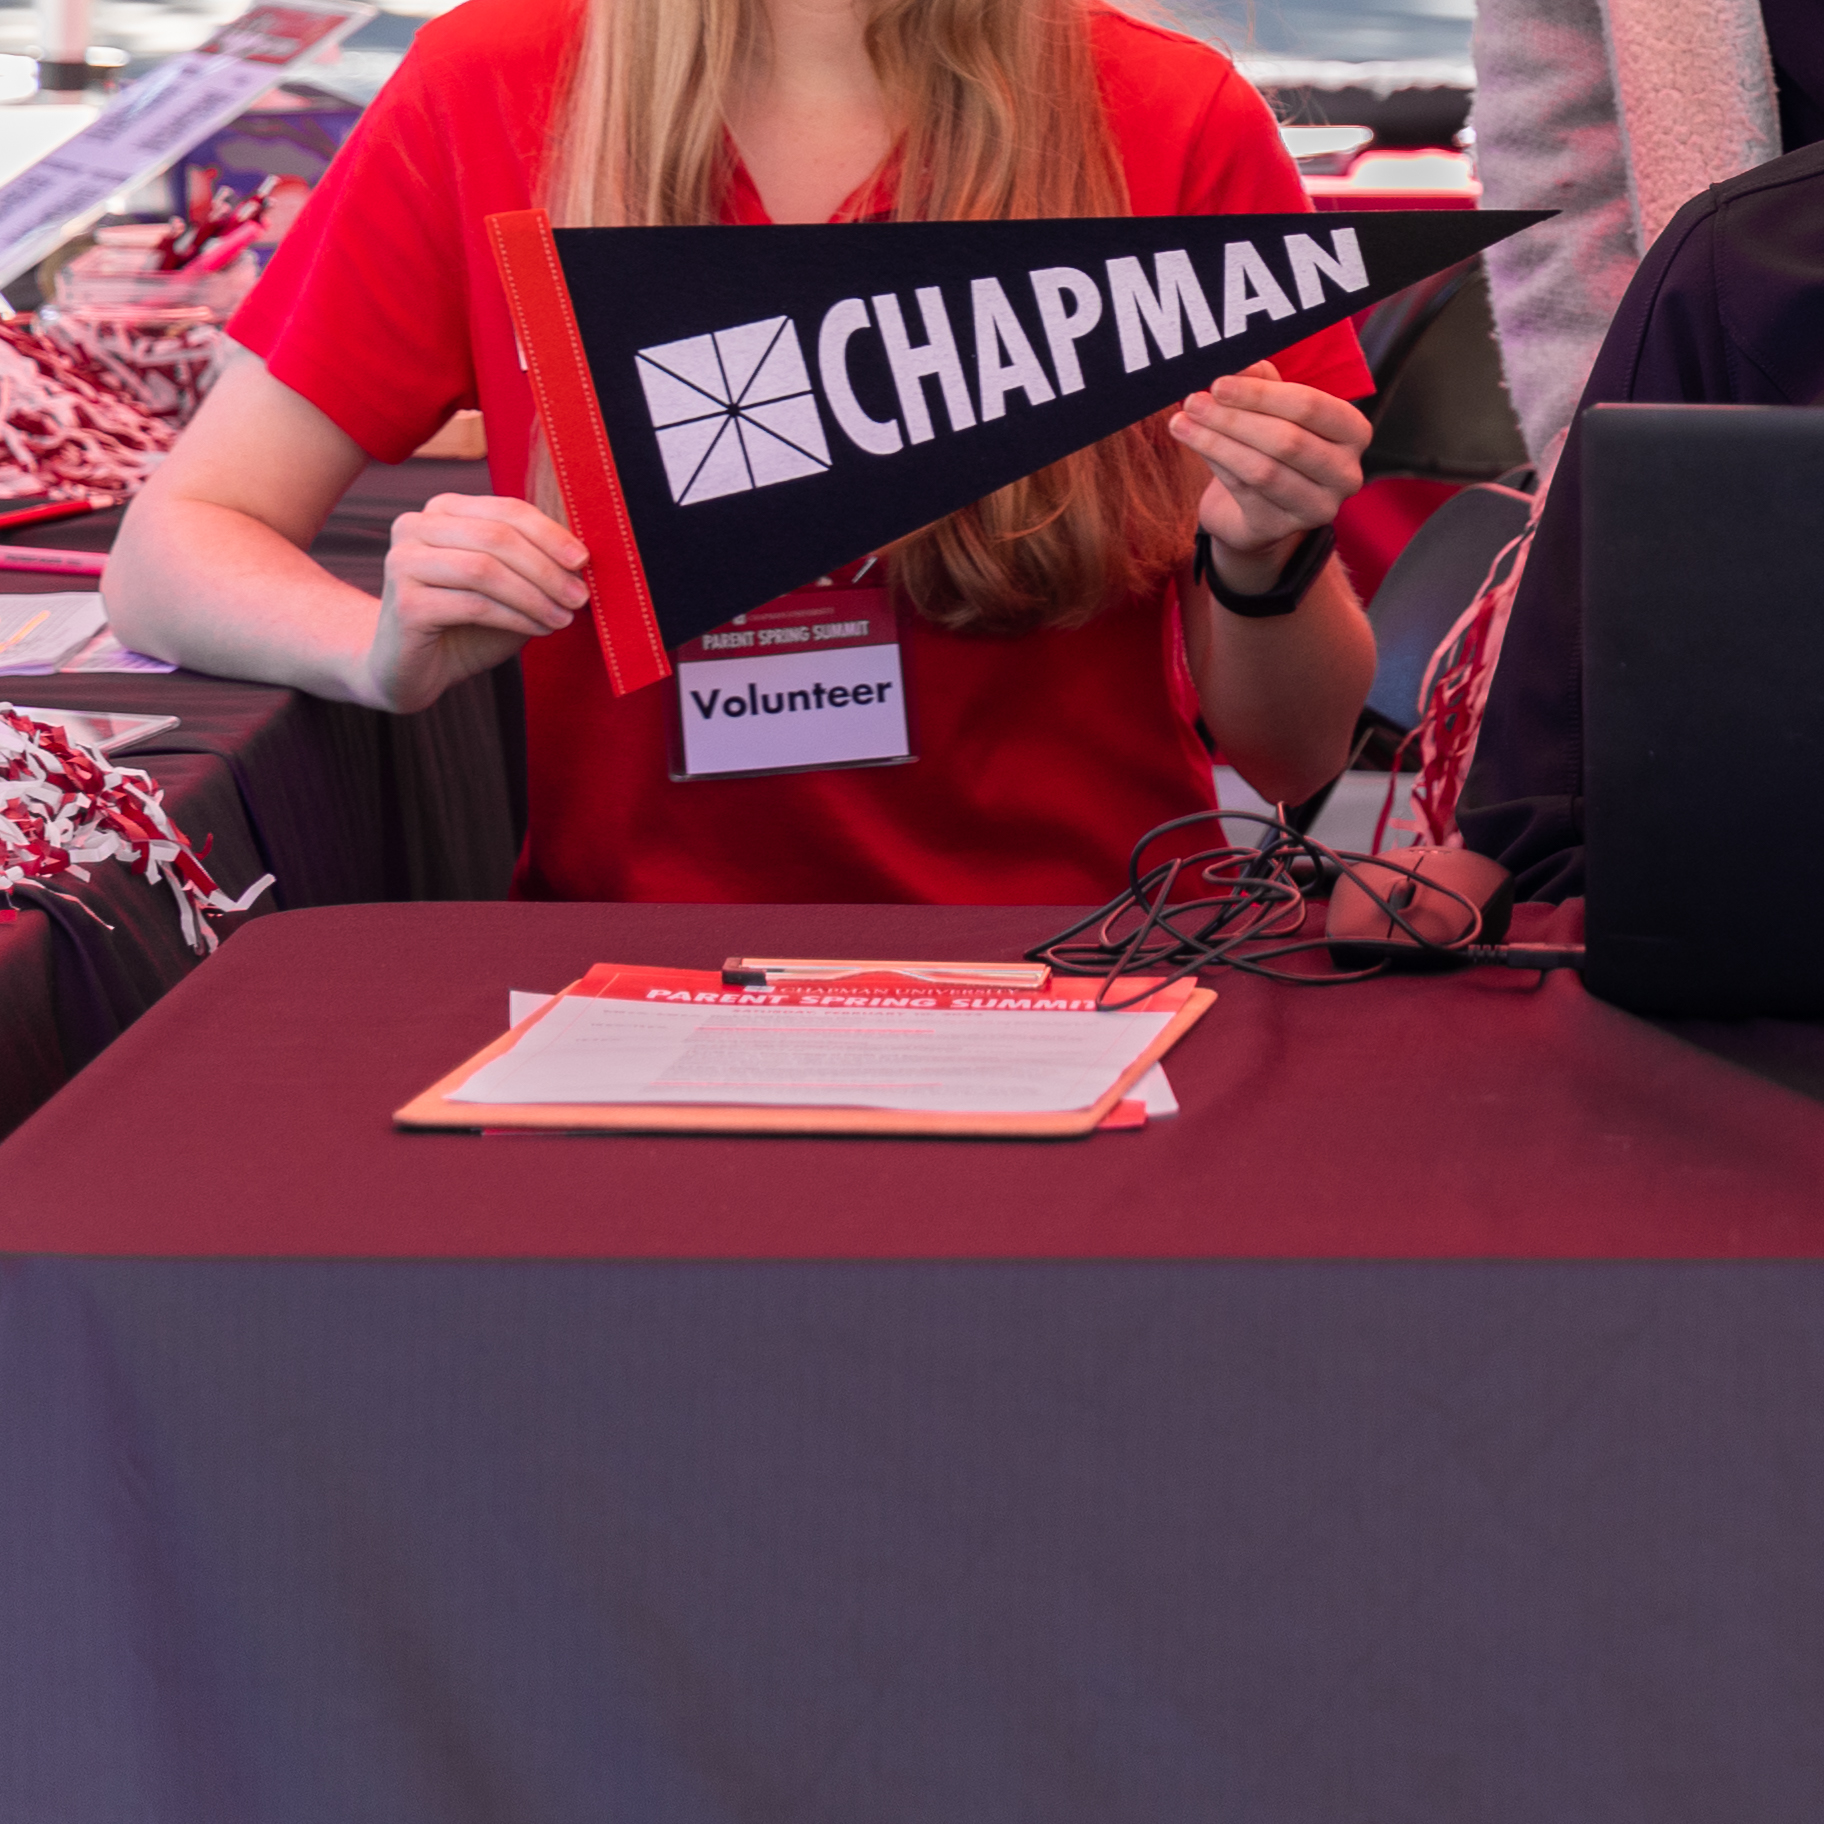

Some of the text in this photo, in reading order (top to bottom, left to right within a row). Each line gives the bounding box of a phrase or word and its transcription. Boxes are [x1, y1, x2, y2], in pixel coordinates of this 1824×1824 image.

[816, 226, 1370, 455] CHAPMAN
[702, 620, 870, 651] PARENT SPRING SUMMIT
[690, 682, 893, 719] Volunteer
[645, 988, 790, 1005] PARENT
[798, 995, 938, 1008] SPRING
